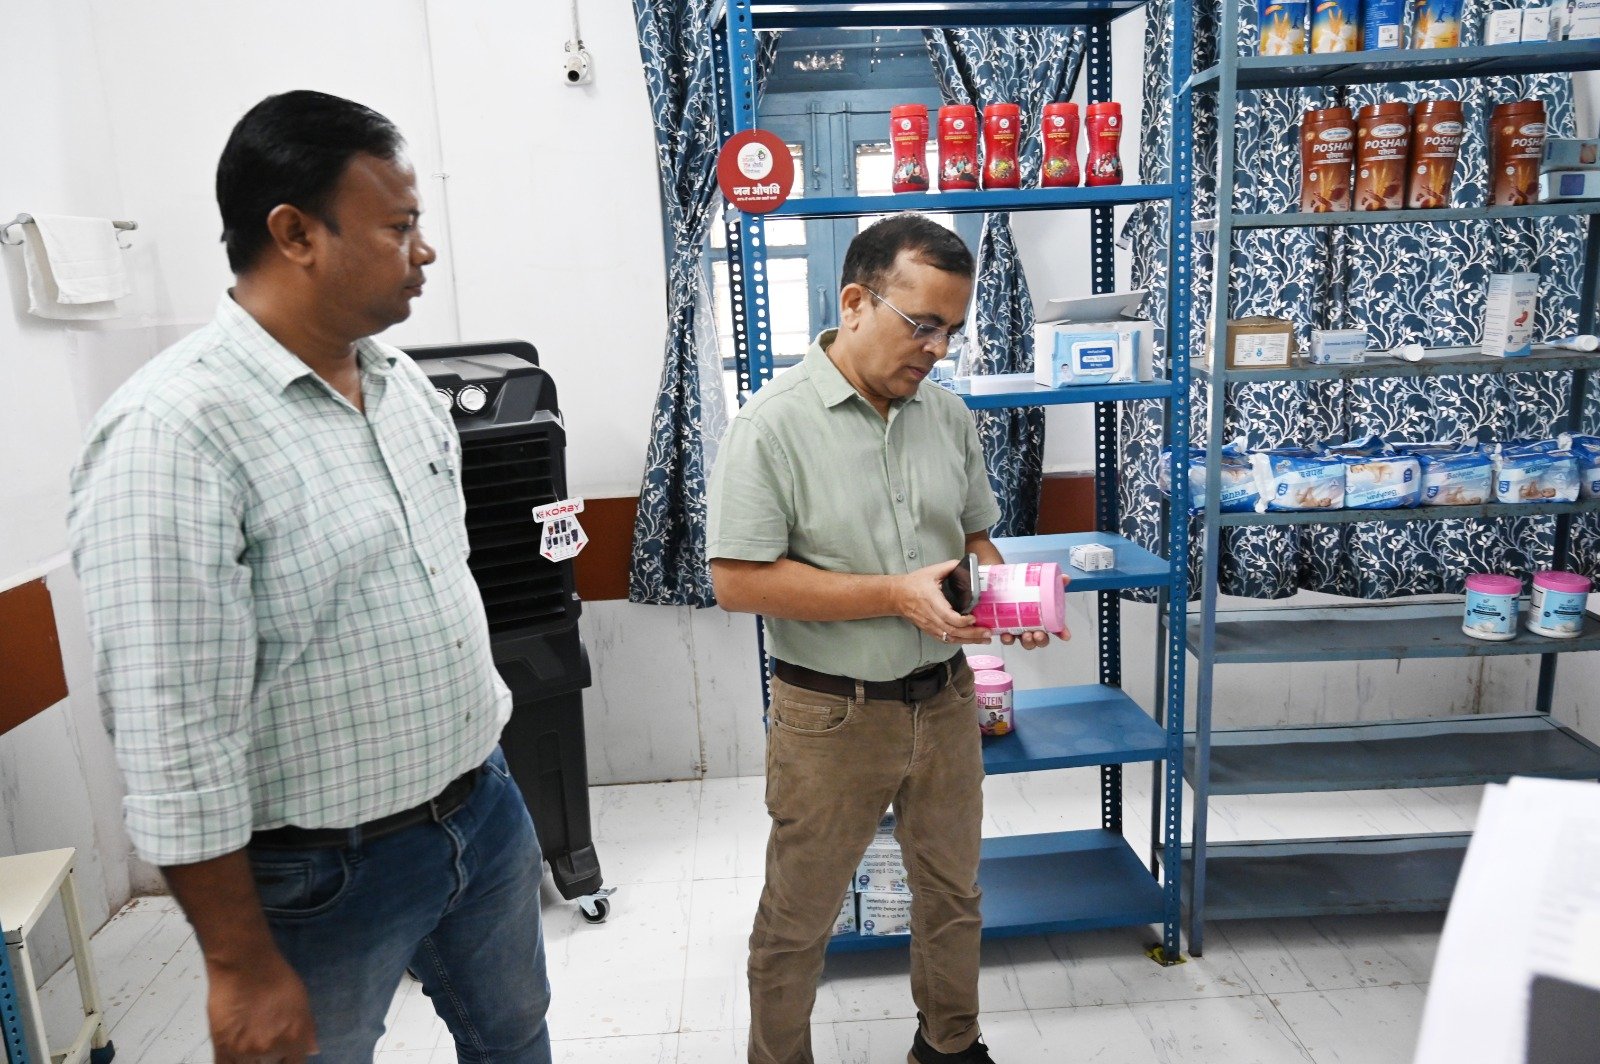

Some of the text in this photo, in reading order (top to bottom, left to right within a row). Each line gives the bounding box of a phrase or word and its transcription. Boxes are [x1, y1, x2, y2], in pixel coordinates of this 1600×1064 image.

[1313, 142, 1353, 153] POSHAN
[1365, 138, 1407, 149] POSHAN
[733, 183, 780, 195] जन औषधि
[545, 503, 580, 516] KORBY
[977, 695, 1003, 706] ROTEIN
